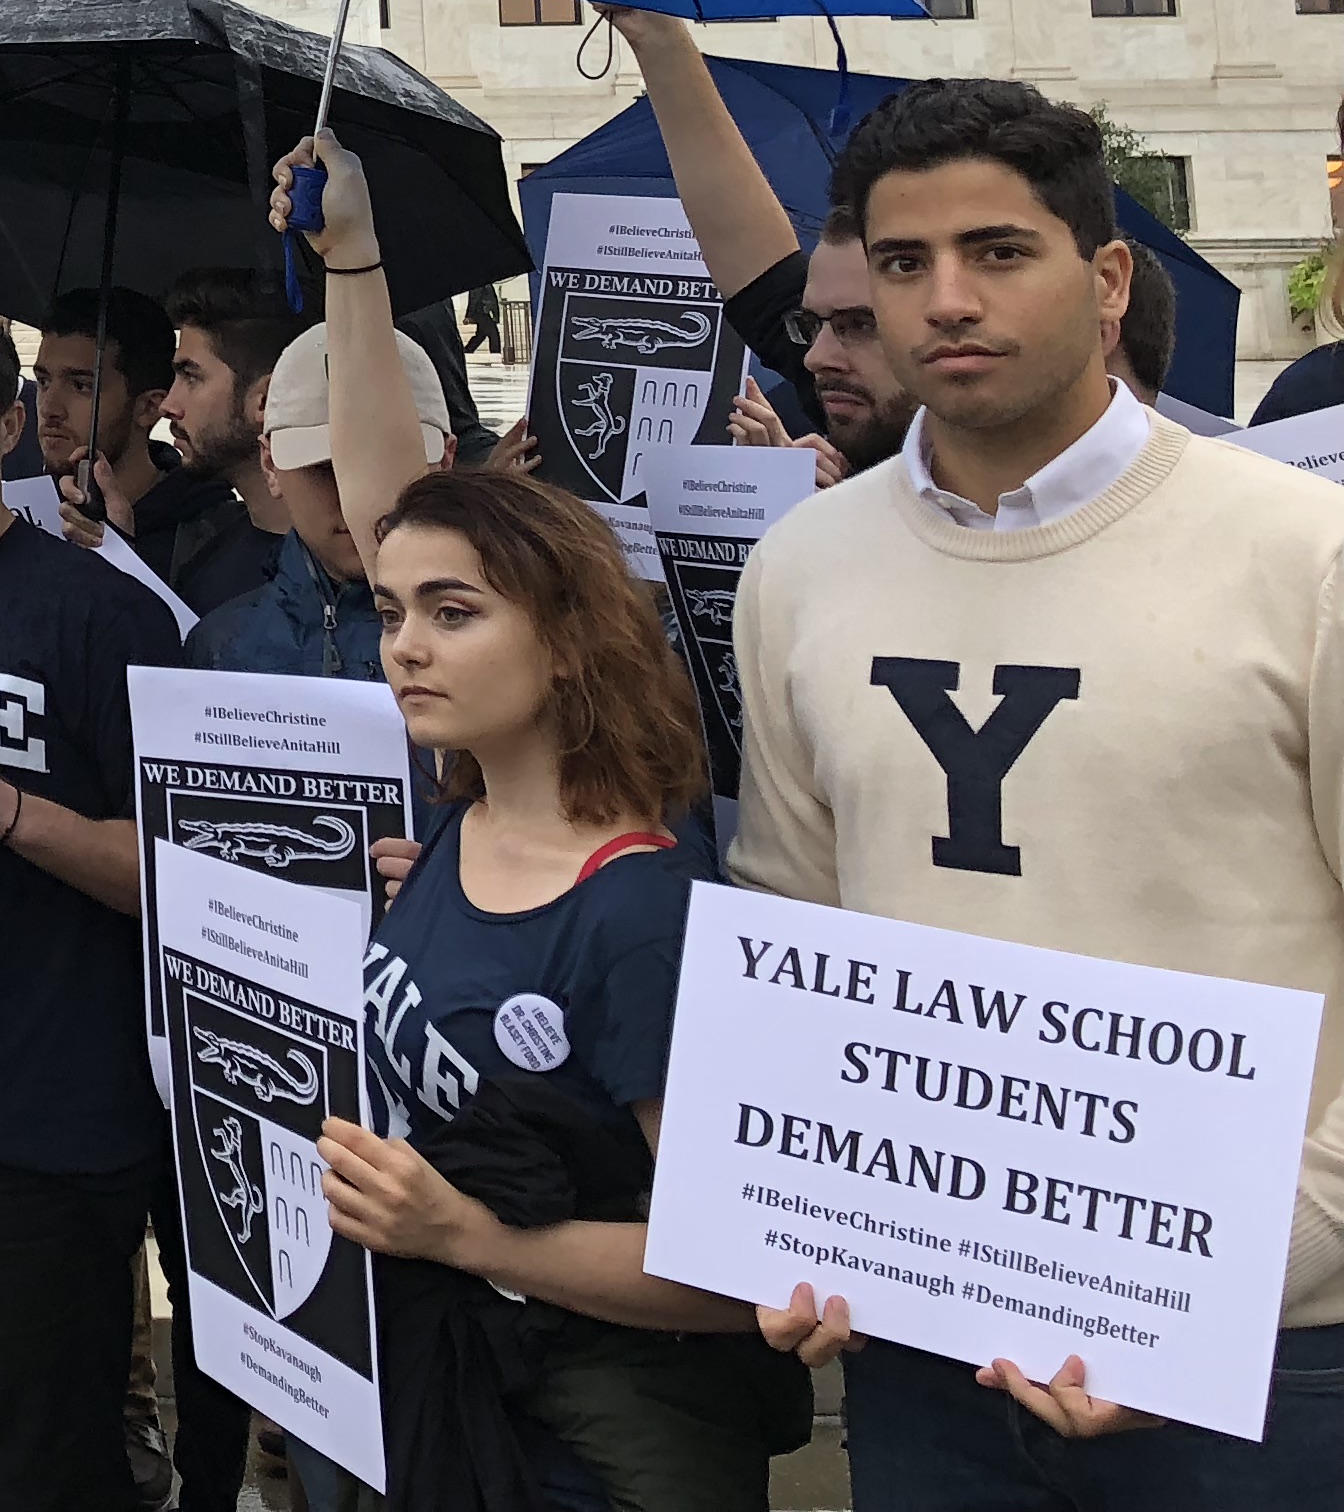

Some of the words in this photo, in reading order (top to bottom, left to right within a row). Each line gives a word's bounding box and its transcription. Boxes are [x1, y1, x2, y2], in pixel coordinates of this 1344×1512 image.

[597, 245, 702, 261] #IStillBelieveAnitaH
[609, 224, 695, 239] #IBelieveChristi
[548, 271, 580, 289] WE
[584, 274, 673, 297] DEMAND
[676, 281, 722, 300] BET
[658, 538, 679, 557] WE
[679, 539, 735, 562] DEMAND
[204, 705, 327, 727] #IBelieveChristine
[194, 731, 341, 755] #IStillBelieveAnitaHill
[870, 656, 1081, 876] Y
[142, 762, 180, 786] WE
[185, 766, 296, 796] DEMAND
[302, 776, 402, 805] BETTER
[208, 898, 299, 943] #IBelieveChristine
[201, 926, 309, 979] #IStillBelieveAnitaHill
[165, 953, 194, 984] WE
[196, 965, 275, 1018] DEMAND
[278, 999, 357, 1052] BETTER
[534, 1011, 563, 1046] BELIEVE
[737, 936, 879, 1006] YALE
[892, 969, 1027, 1034] LAW
[1038, 1001, 1256, 1080] SCHOOL
[500, 1013, 527, 1046] BLASEY
[521, 1045, 541, 1069] FORD
[522, 1018, 555, 1064] CHRISTINE
[840, 1041, 1139, 1145] STUDENTS
[734, 1102, 987, 1201] DEMAND
[1002, 1167, 1215, 1258] BETTER
[741, 1182, 952, 1255] #IBelieveChristine
[957, 1236, 1191, 1313] #IStillBelieveAnitaHill
[763, 1228, 955, 1297] #StopKavanaugh
[960, 1279, 1160, 1348] #DemandingBetter
[243, 1322, 322, 1384] #StopKavanaugh
[240, 1352, 330, 1419] #DemandingBetter
